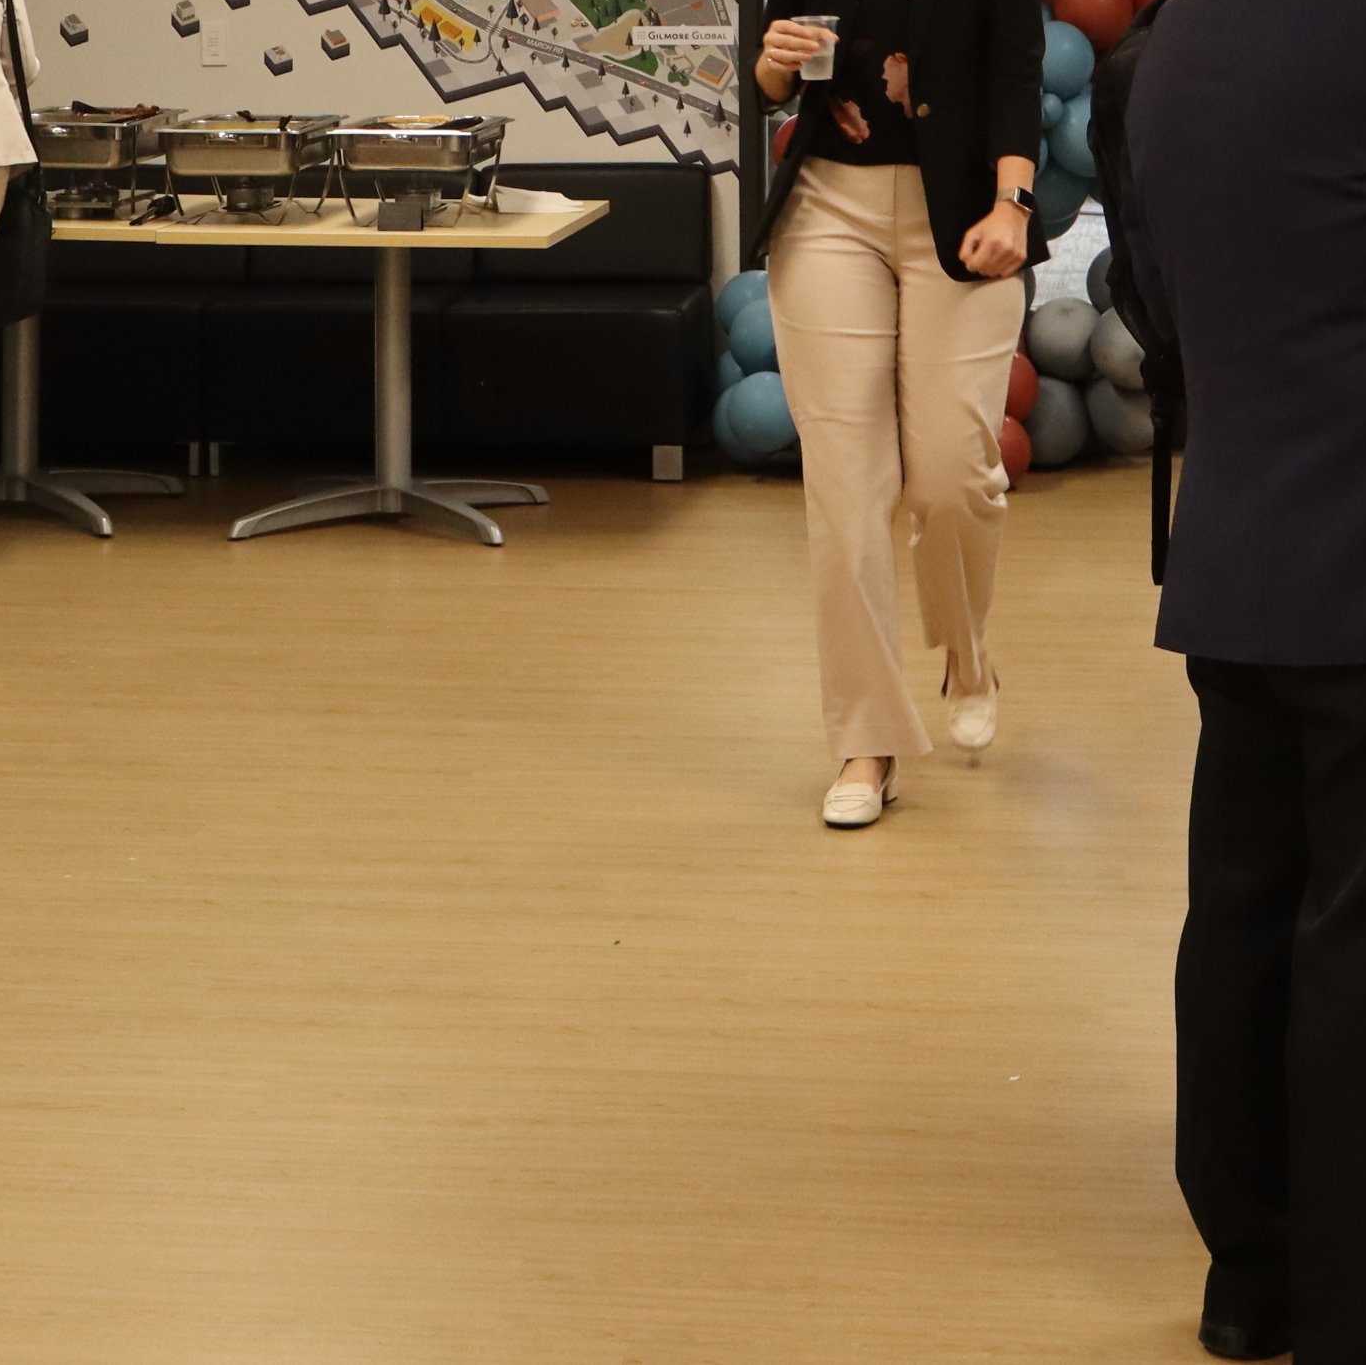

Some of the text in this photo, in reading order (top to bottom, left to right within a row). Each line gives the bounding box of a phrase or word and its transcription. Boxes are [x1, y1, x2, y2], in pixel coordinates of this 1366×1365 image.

[648, 31, 727, 40] GILMORE GLOBAL
[527, 38, 565, 55] MARCH RD
